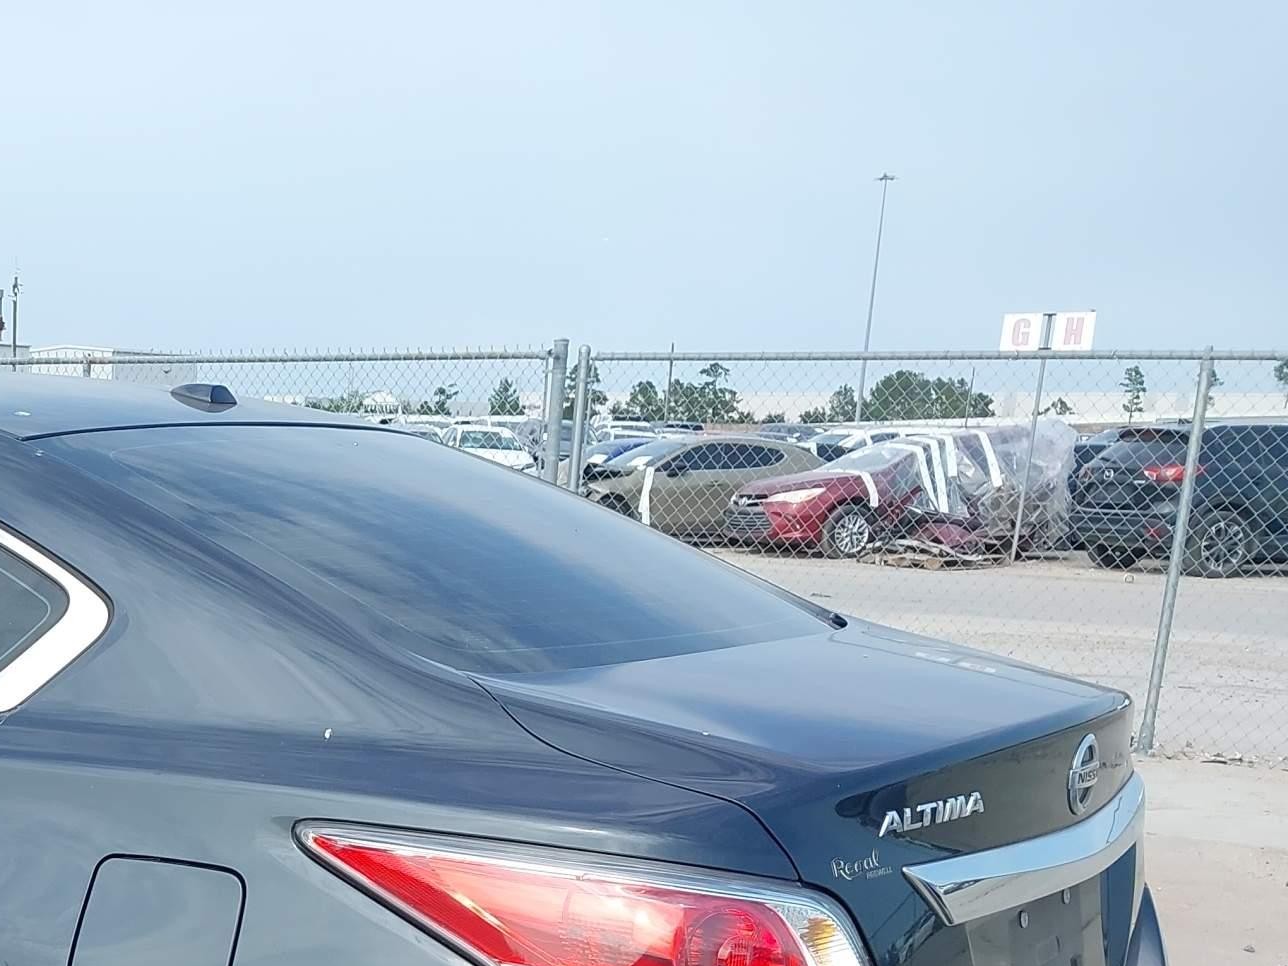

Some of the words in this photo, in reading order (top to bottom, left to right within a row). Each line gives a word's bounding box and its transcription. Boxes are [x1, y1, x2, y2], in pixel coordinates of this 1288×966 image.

[1012, 318, 1031, 346] G
[1064, 317, 1085, 345] H
[1077, 768, 1098, 785] NISS
[878, 791, 985, 838] ALTIMA
